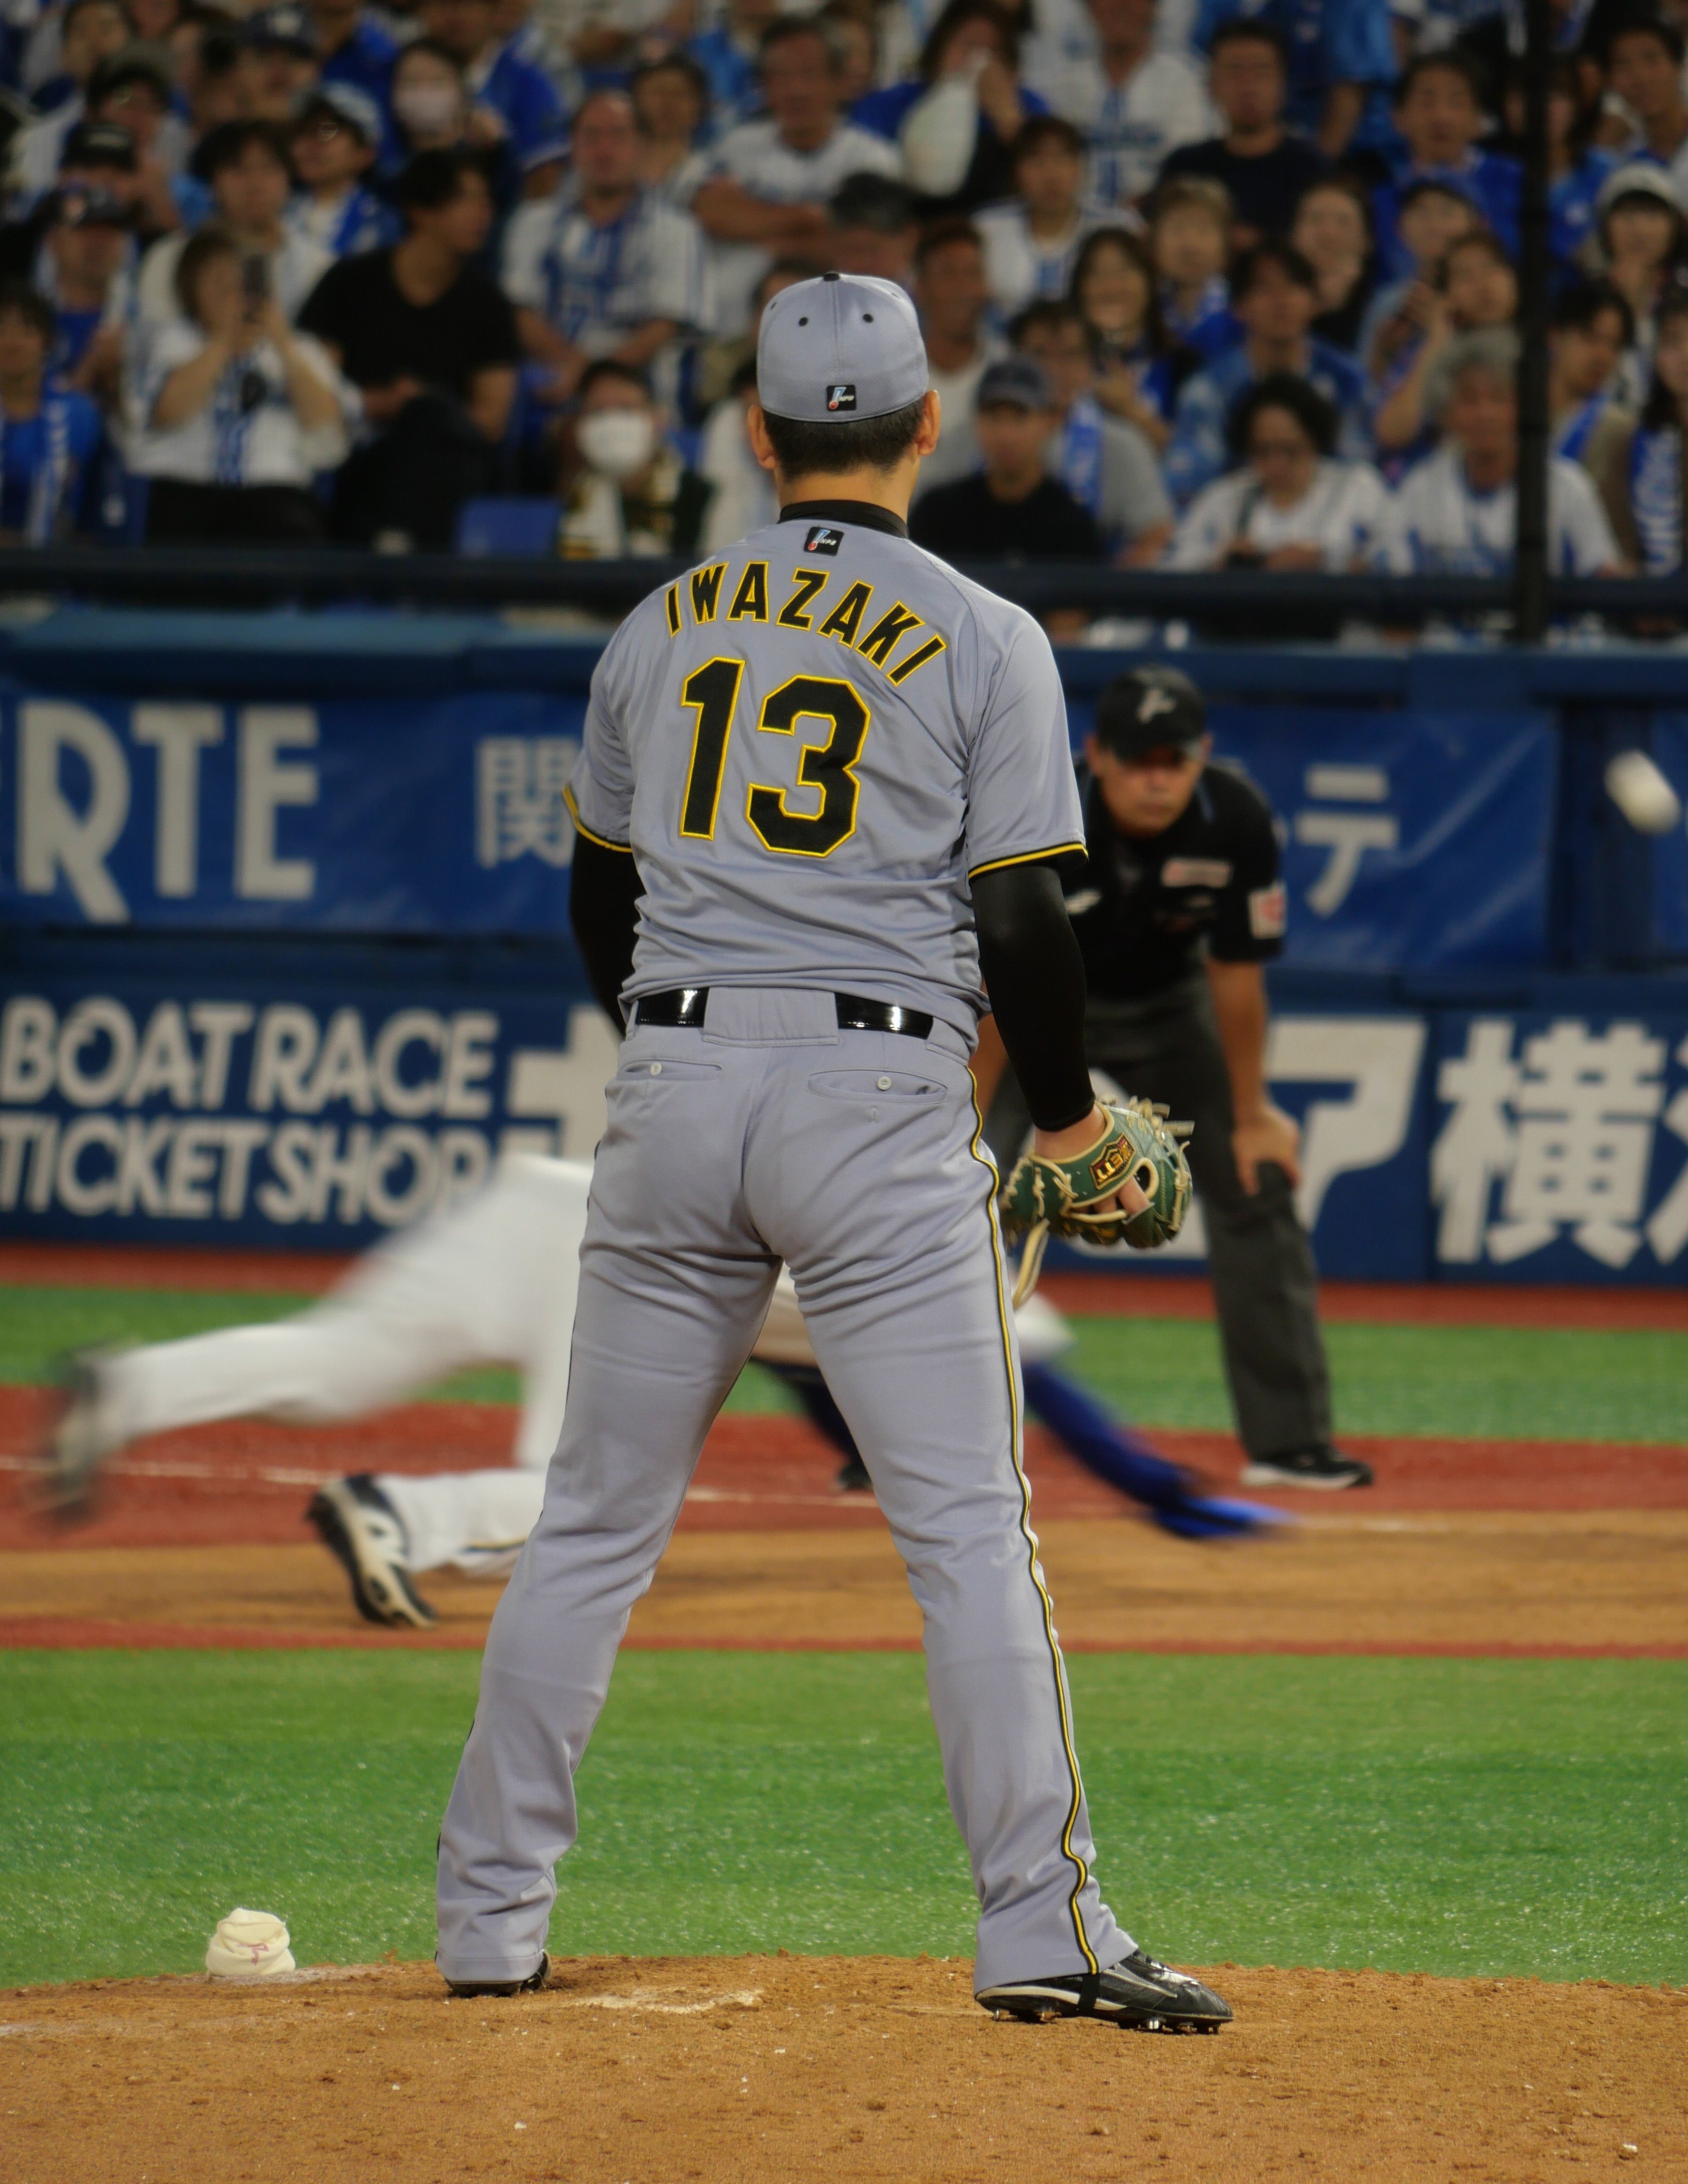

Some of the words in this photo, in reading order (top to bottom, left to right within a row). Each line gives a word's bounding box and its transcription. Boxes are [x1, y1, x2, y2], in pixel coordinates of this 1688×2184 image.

[665, 561, 947, 687] IWAZAKI
[680, 656, 871, 858] 13
[1295, 763, 1399, 919] テ
[1096, 1139, 1131, 1184] ZETT
